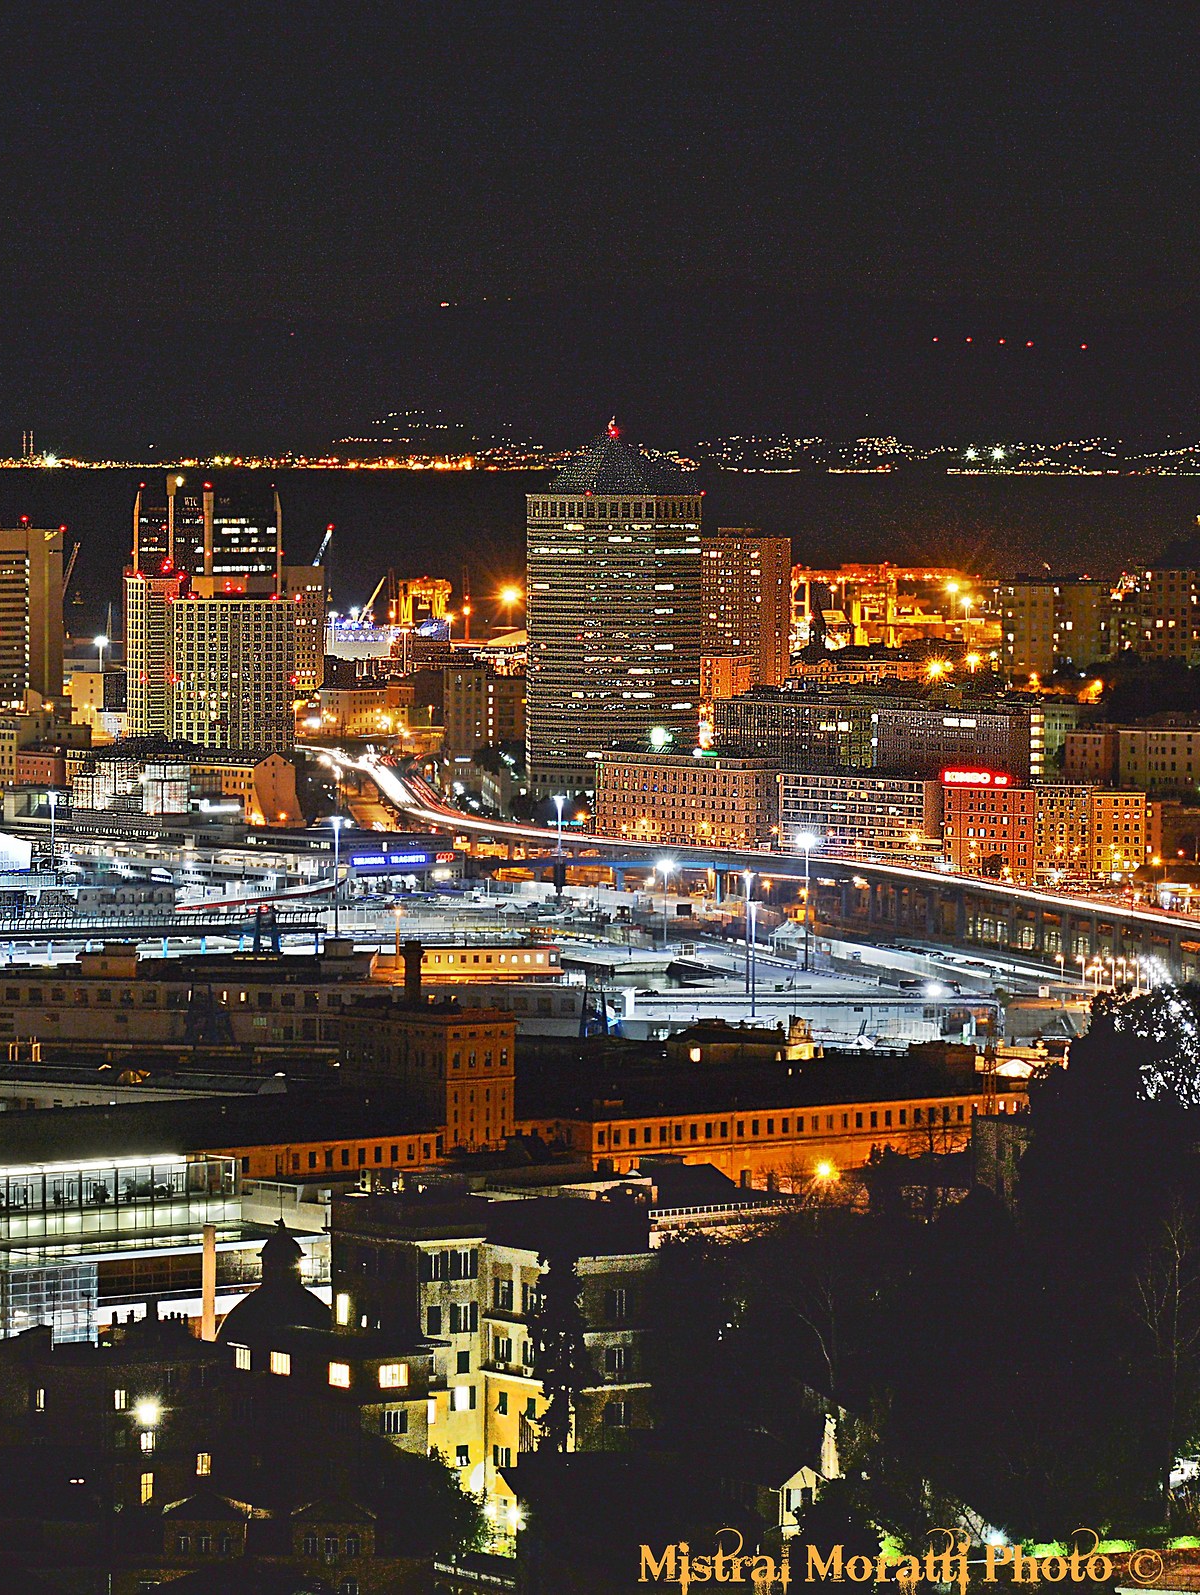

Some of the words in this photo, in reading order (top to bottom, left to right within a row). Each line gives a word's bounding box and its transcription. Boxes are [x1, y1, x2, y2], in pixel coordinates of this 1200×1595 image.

[944, 771, 991, 784] KIMBO
[352, 857, 386, 865] TERMINAL
[390, 854, 426, 864] TRAGHETTI
